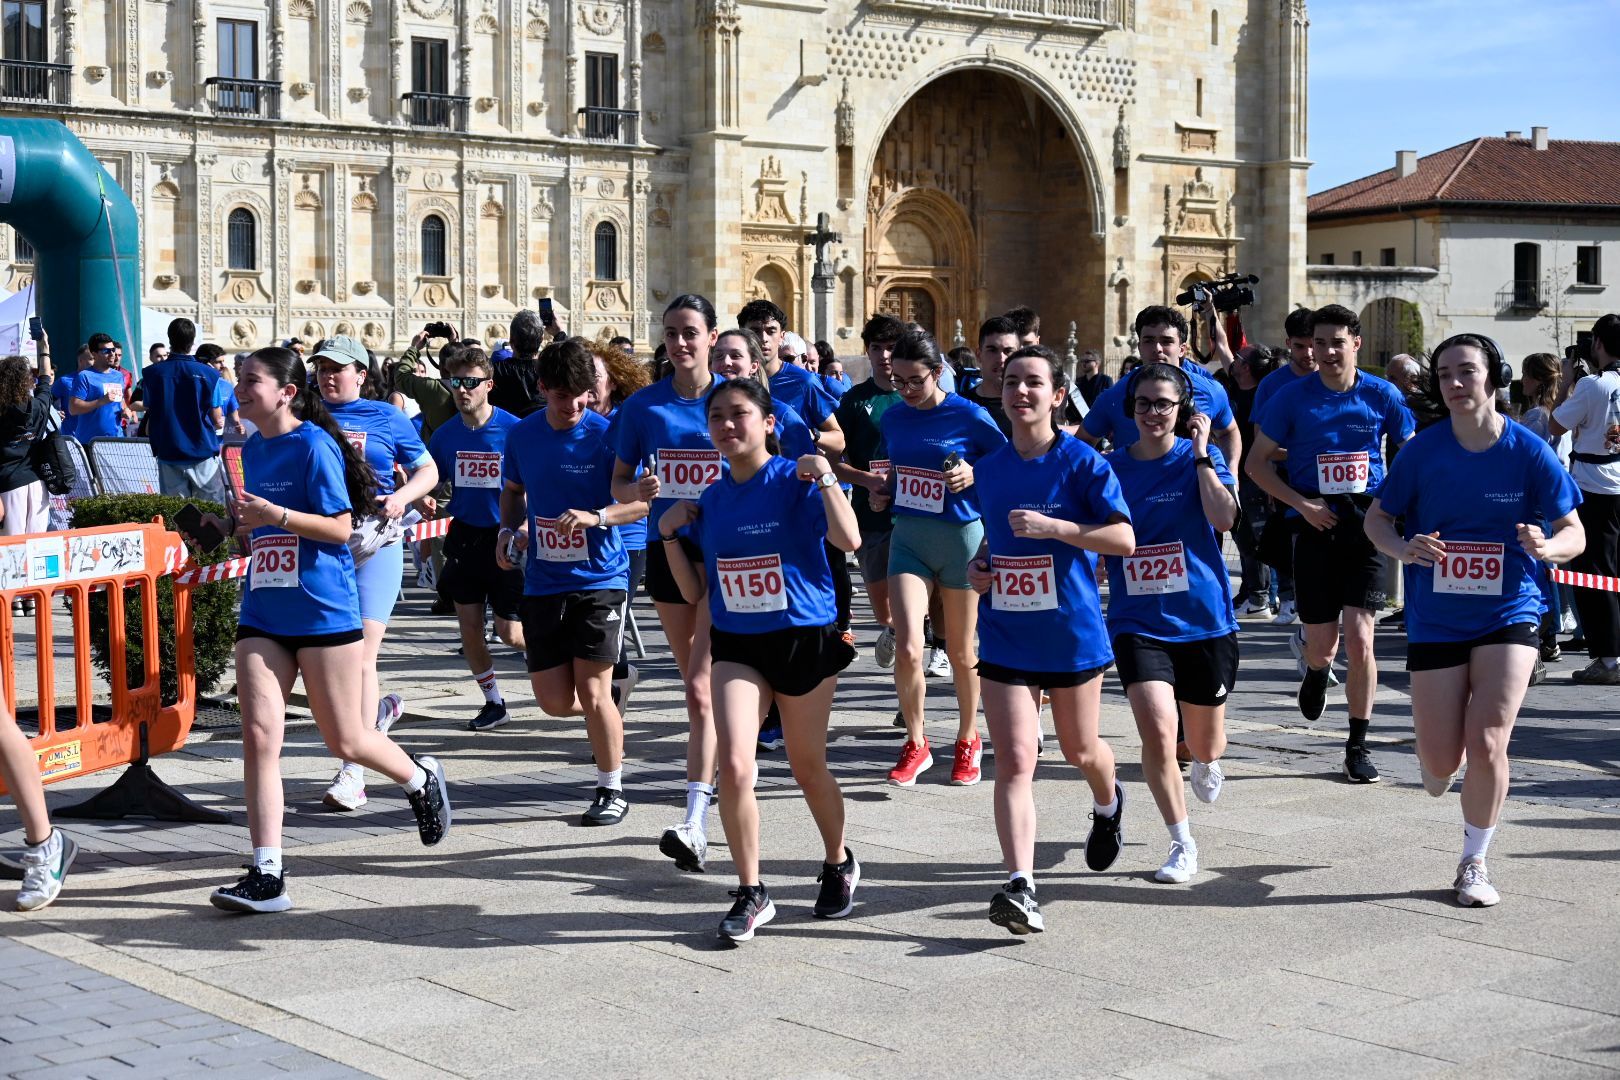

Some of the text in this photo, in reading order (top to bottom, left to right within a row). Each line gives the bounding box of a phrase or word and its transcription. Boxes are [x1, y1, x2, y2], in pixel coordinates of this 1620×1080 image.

[458, 462, 500, 478] 1256
[661, 462, 720, 486] 1002
[1322, 464, 1367, 483] 1083
[900, 476, 942, 501] 1003
[738, 524, 759, 532] CASTILLA
[538, 530, 584, 550] 1035
[255, 550, 296, 573] 203
[762, 558, 776, 566] LEÓN
[1127, 557, 1184, 581] 1224
[1439, 556, 1500, 580] 1059
[722, 572, 782, 597] 1150
[994, 572, 1049, 596] 1261
